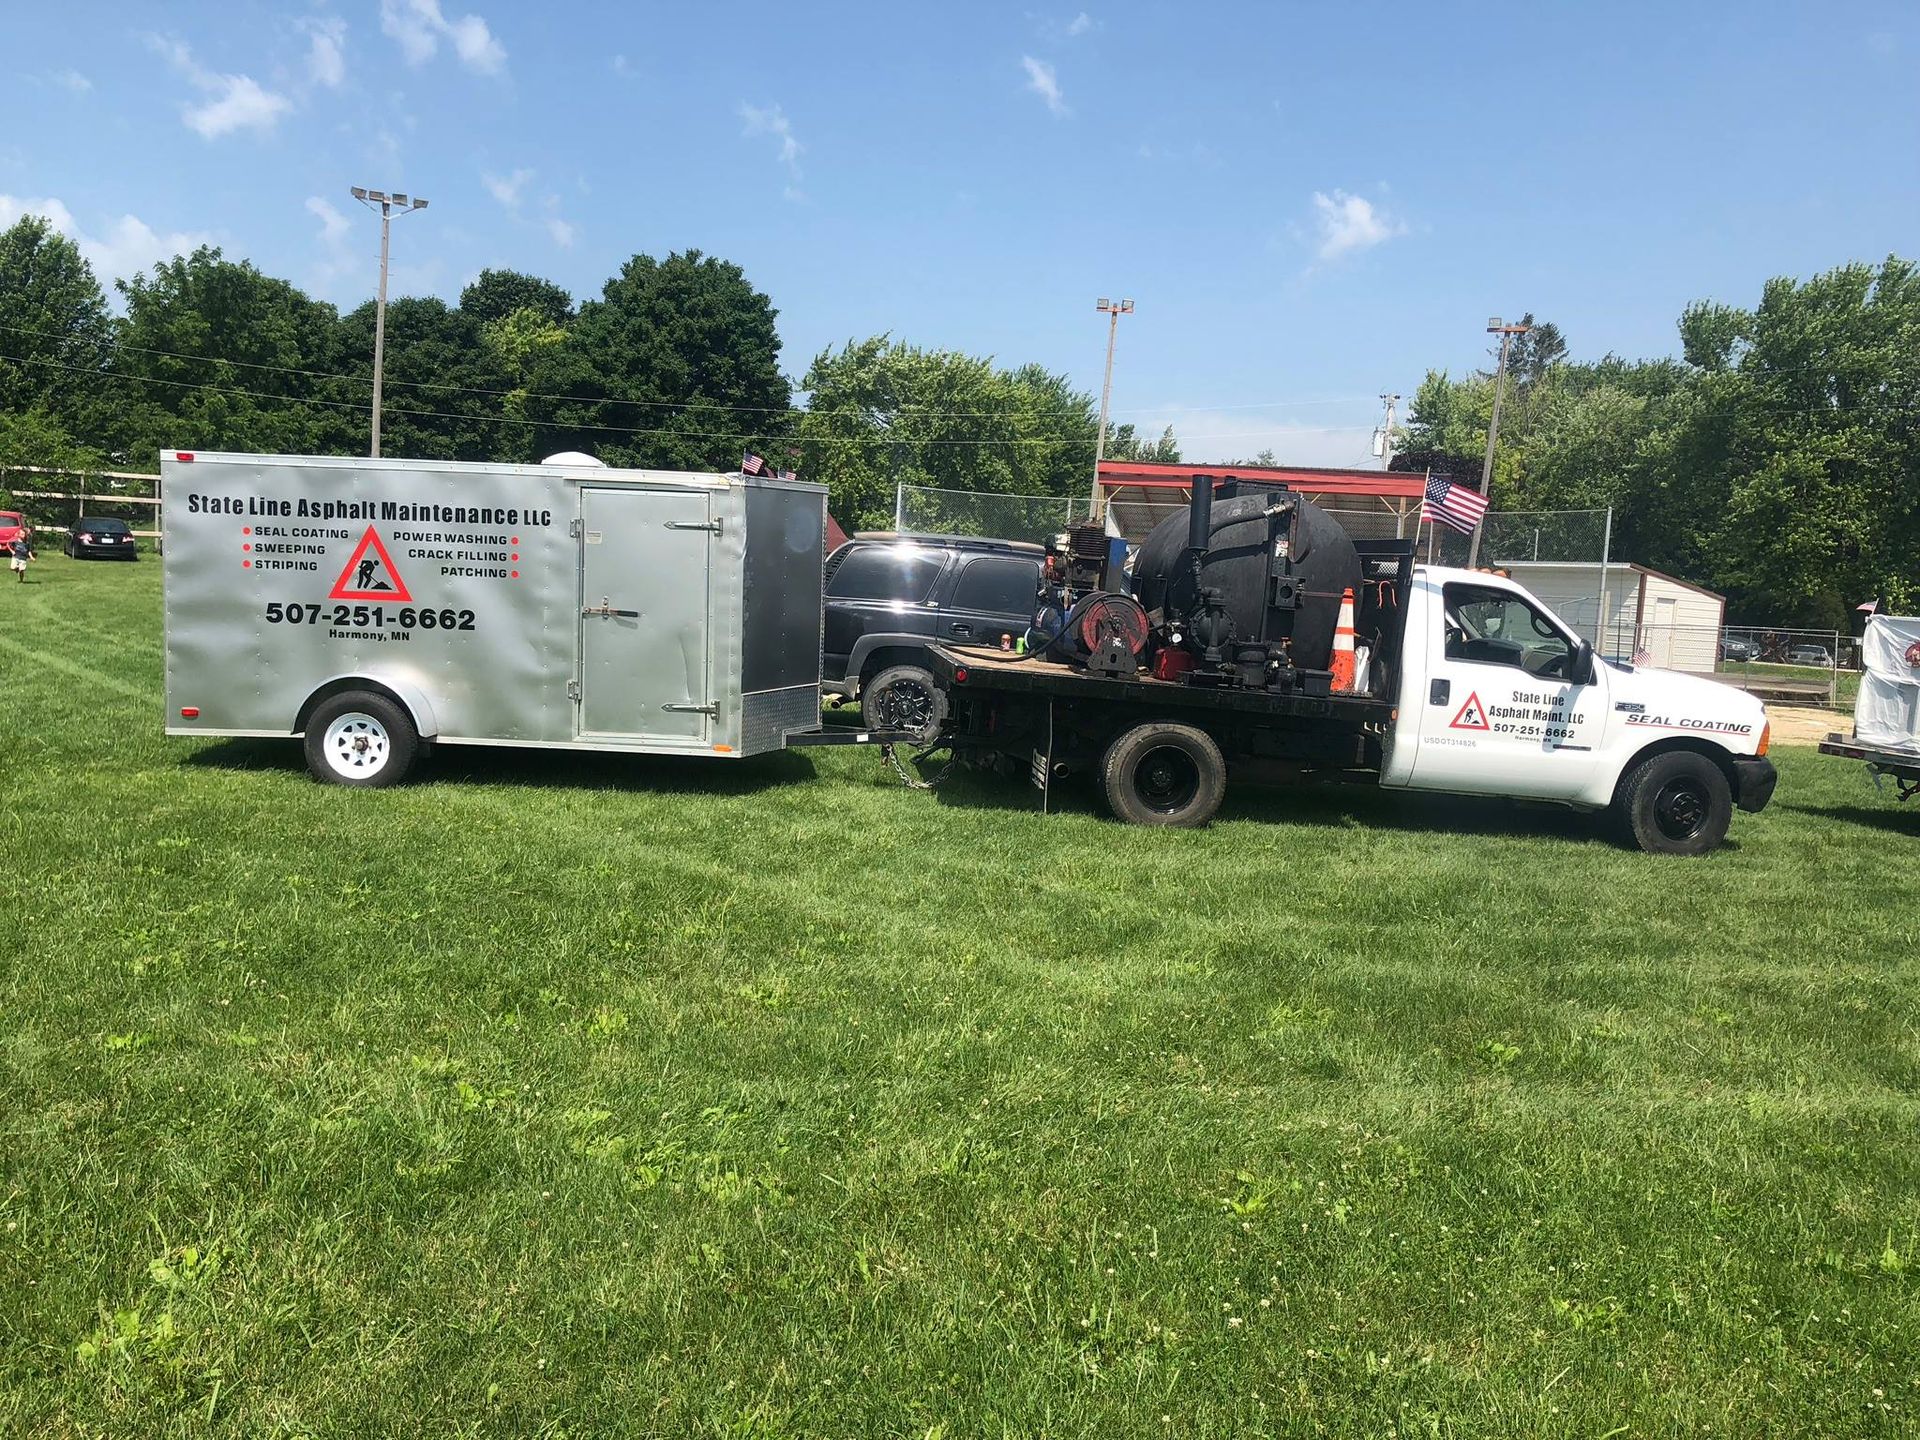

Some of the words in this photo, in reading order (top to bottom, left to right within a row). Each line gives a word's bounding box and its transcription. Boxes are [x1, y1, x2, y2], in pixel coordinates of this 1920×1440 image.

[187, 493, 244, 516] State
[248, 496, 292, 517] Line
[297, 499, 377, 521] Asphalt
[381, 502, 519, 526] Maintenance
[523, 510, 552, 527] LLC
[254, 526, 288, 537] SEAL
[291, 527, 349, 540] COATING
[393, 531, 442, 543] POWER
[444, 533, 508, 546] WASHING
[254, 543, 326, 556] SWEEPING
[408, 549, 453, 560] CRACK
[457, 551, 507, 562] FILLING
[254, 559, 318, 571] STRIPING
[441, 567, 508, 579] PATCHING
[266, 603, 476, 630] 507-251-6662
[329, 629, 387, 642] Harmony,
[391, 632, 411, 641] MN
[1512, 690, 1540, 704] State
[1543, 693, 1565, 706] Line
[1489, 705, 1530, 719] Asphalt
[1532, 709, 1565, 723] Maint.
[1568, 713, 1584, 724] LLC
[1493, 723, 1575, 739] 507-251-6662
[1627, 714, 1673, 725] SEAL
[1679, 718, 1752, 733] COATING
